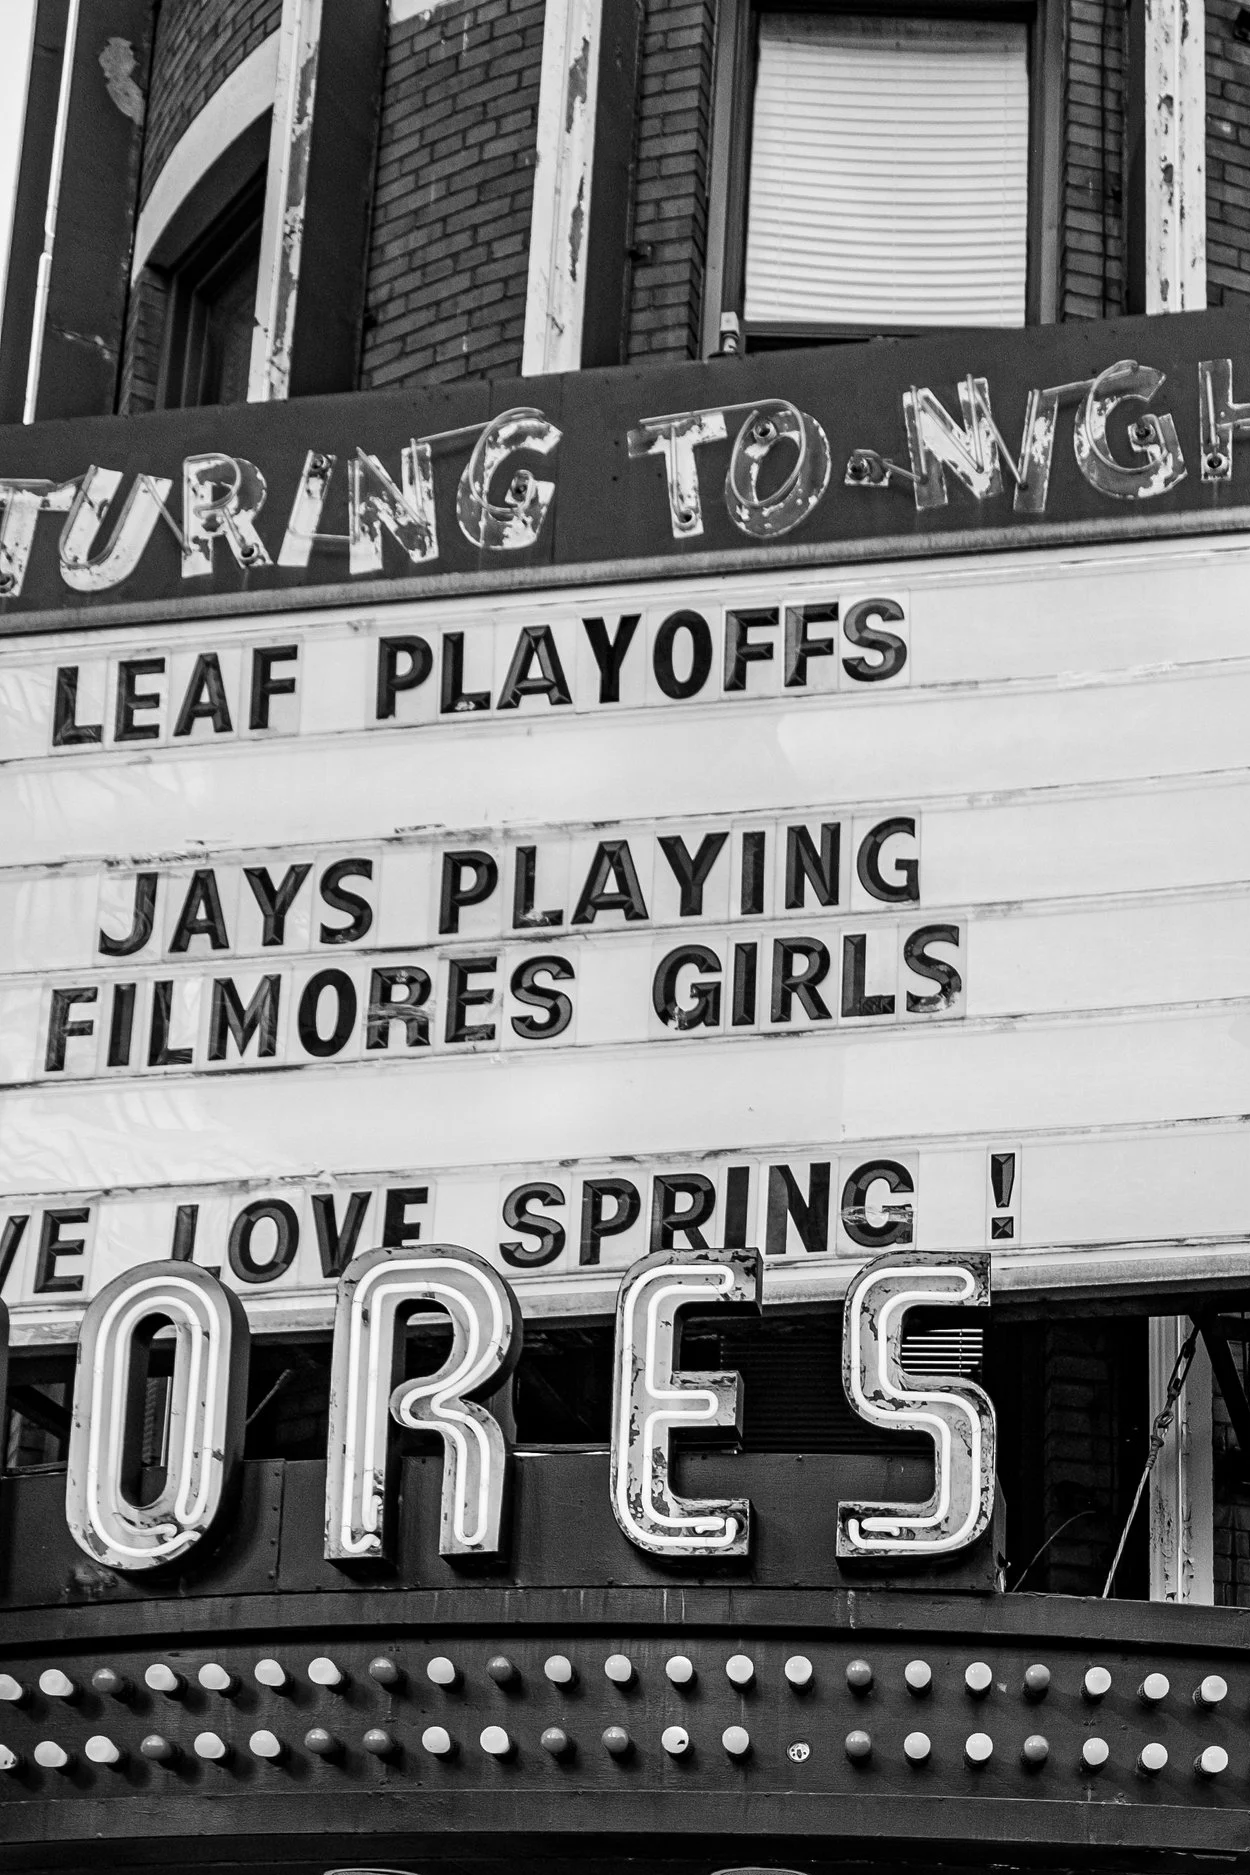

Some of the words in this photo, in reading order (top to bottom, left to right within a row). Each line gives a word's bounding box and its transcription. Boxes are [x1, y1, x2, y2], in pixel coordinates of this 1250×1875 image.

[52, 645, 300, 746] LEAF
[377, 598, 908, 719] PLAYOFFS
[98, 857, 374, 957] JAYS
[440, 816, 921, 934] PLAYING
[44, 955, 575, 1072] FILMORES
[653, 924, 962, 1031] GIRLS
[172, 1186, 429, 1284] LOVE
[500, 1158, 915, 1268] SPRING
[990, 1153, 1016, 1239] !
